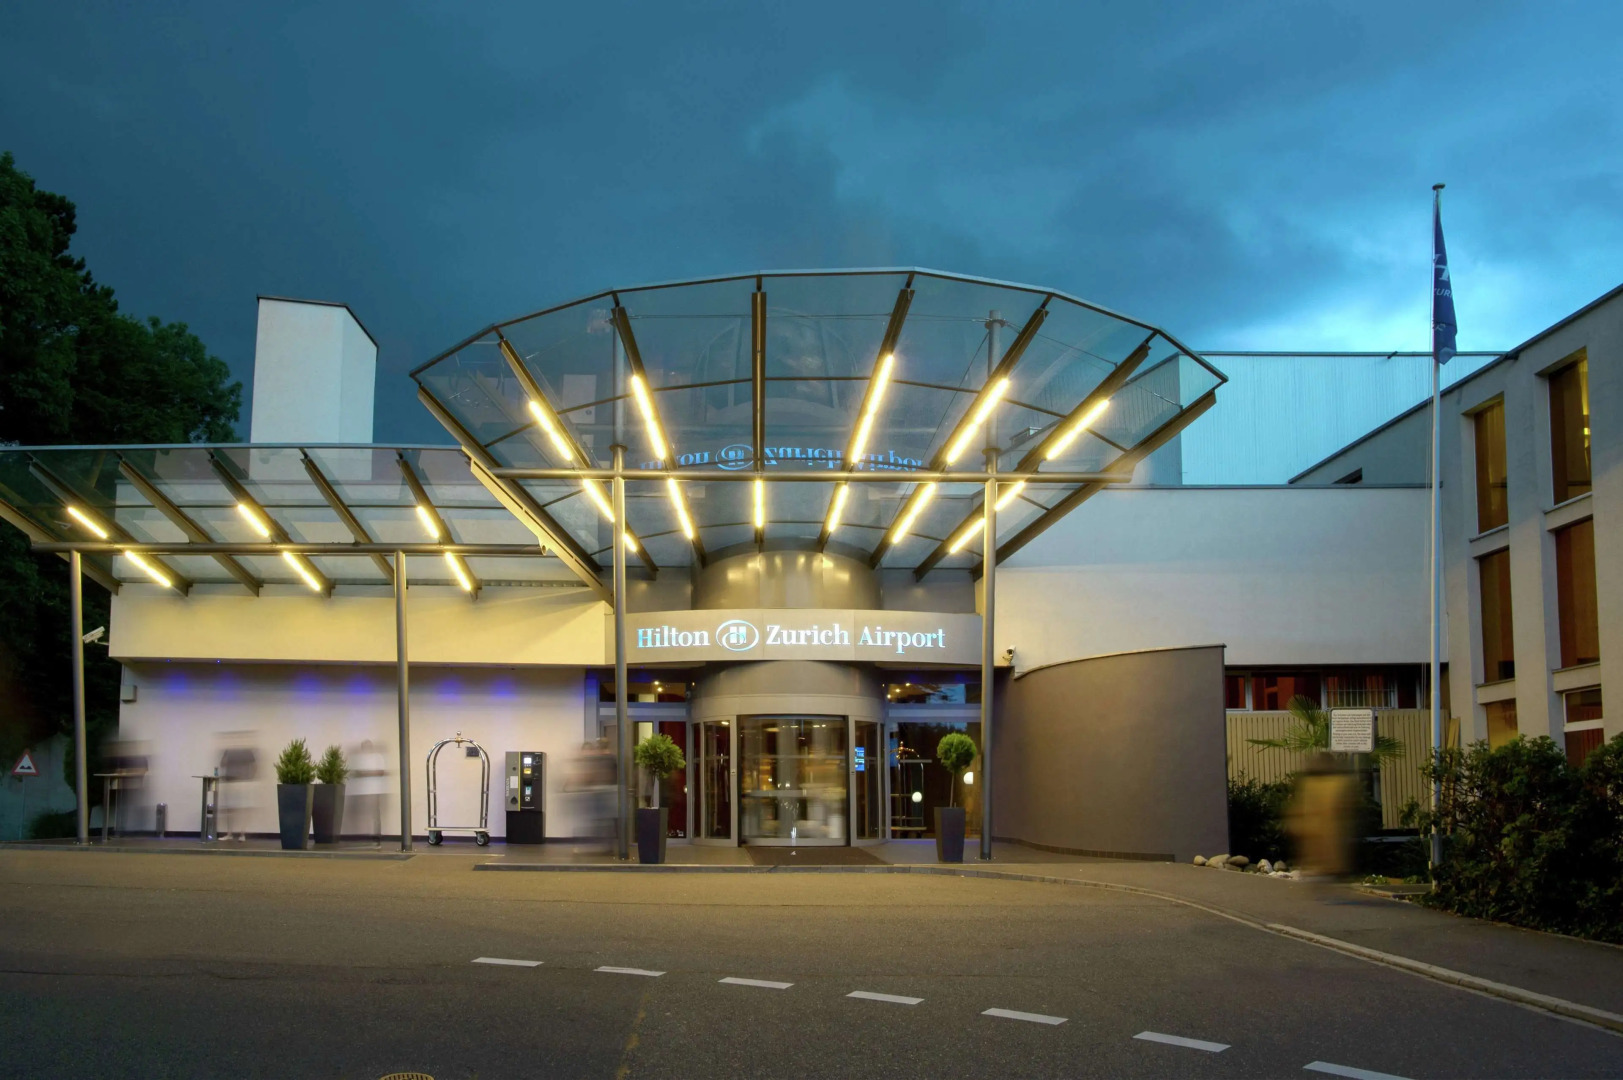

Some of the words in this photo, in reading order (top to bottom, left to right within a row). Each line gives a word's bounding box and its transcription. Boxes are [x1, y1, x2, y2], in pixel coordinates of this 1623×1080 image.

[637, 625, 710, 648] Hilton
[765, 623, 851, 645] Zurich
[858, 626, 946, 654] Airport
